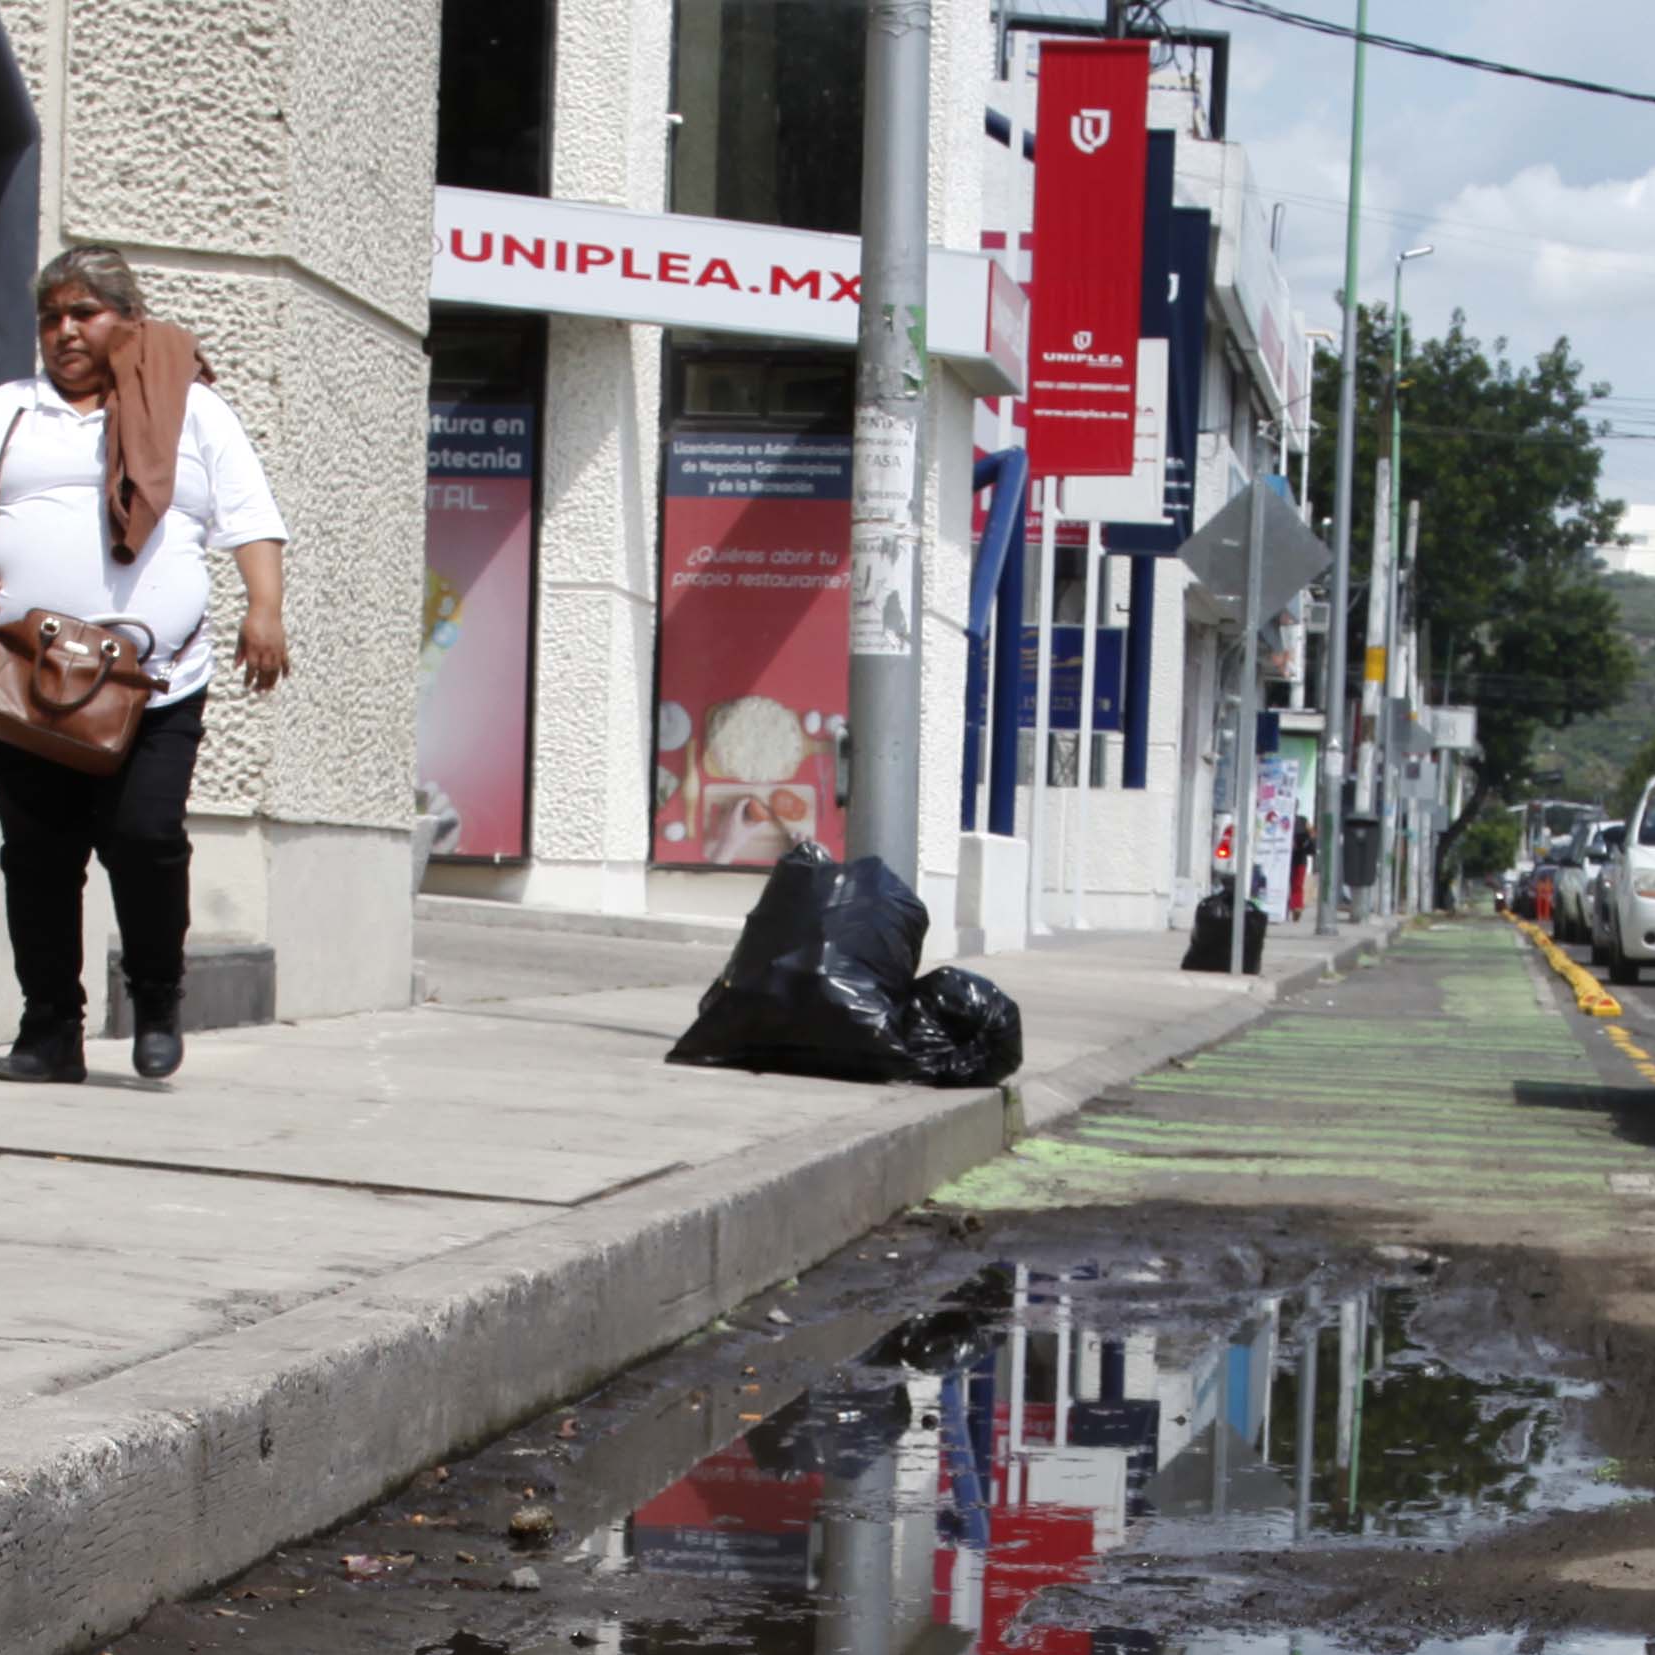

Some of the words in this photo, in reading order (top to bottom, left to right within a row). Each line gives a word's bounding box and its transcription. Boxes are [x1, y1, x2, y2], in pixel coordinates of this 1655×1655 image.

[450, 228, 863, 303] UNIPLEA.MX
[1042, 352, 1124, 365] UNIPLEA
[427, 414, 487, 435] tura
[492, 417, 526, 435] en
[673, 441, 745, 456] Licenciatura
[747, 445, 763, 456] en
[681, 461, 697, 473] de
[699, 461, 752, 475] Negocios
[708, 482, 716, 494] y
[718, 481, 733, 493] de
[736, 481, 747, 493] la
[770, 549, 813, 564] abrir
[819, 550, 838, 565] tu
[672, 571, 732, 589] propio
[737, 571, 851, 589] restaurante?
